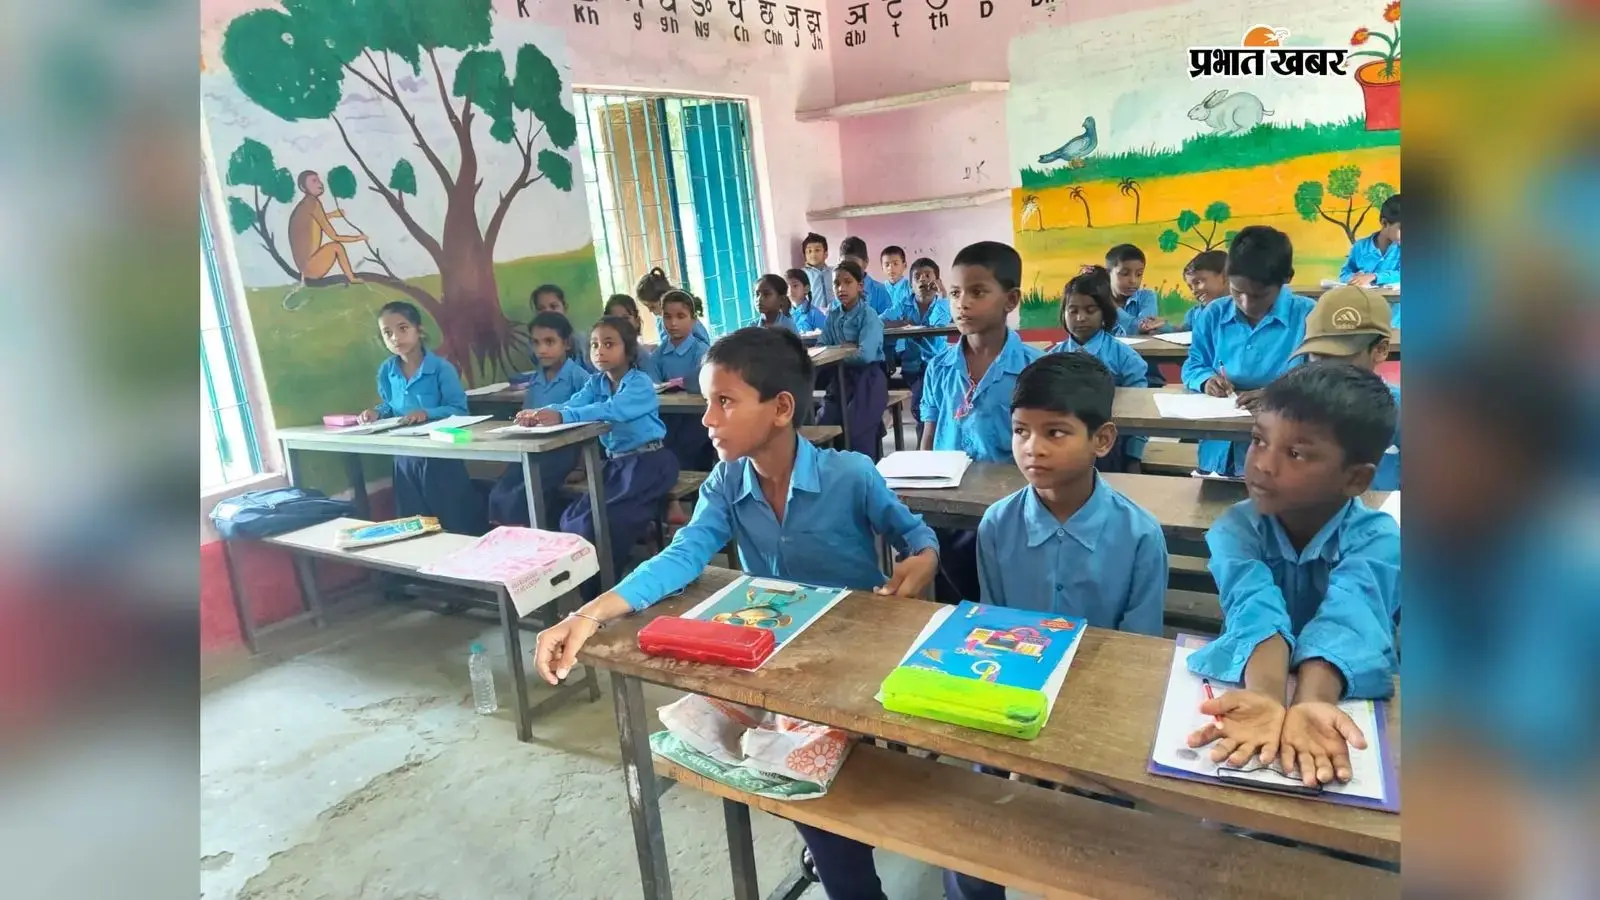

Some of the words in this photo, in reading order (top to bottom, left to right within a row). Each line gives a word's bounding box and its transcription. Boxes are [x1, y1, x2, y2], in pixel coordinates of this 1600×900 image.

[517, 0, 530, 18] K
[573, 4, 599, 25] Kh
[633, 12, 642, 31] g
[660, 16, 679, 34] gh
[694, 20, 710, 38] Ng
[734, 25, 750, 42] Ch
[764, 29, 783, 46] Chh
[758, 0, 776, 26] छ
[784, 5, 801, 30] ज
[803, 9, 821, 34] झ
[892, 21, 900, 38] t
[929, 11, 949, 30] th
[980, 0, 993, 18] D
